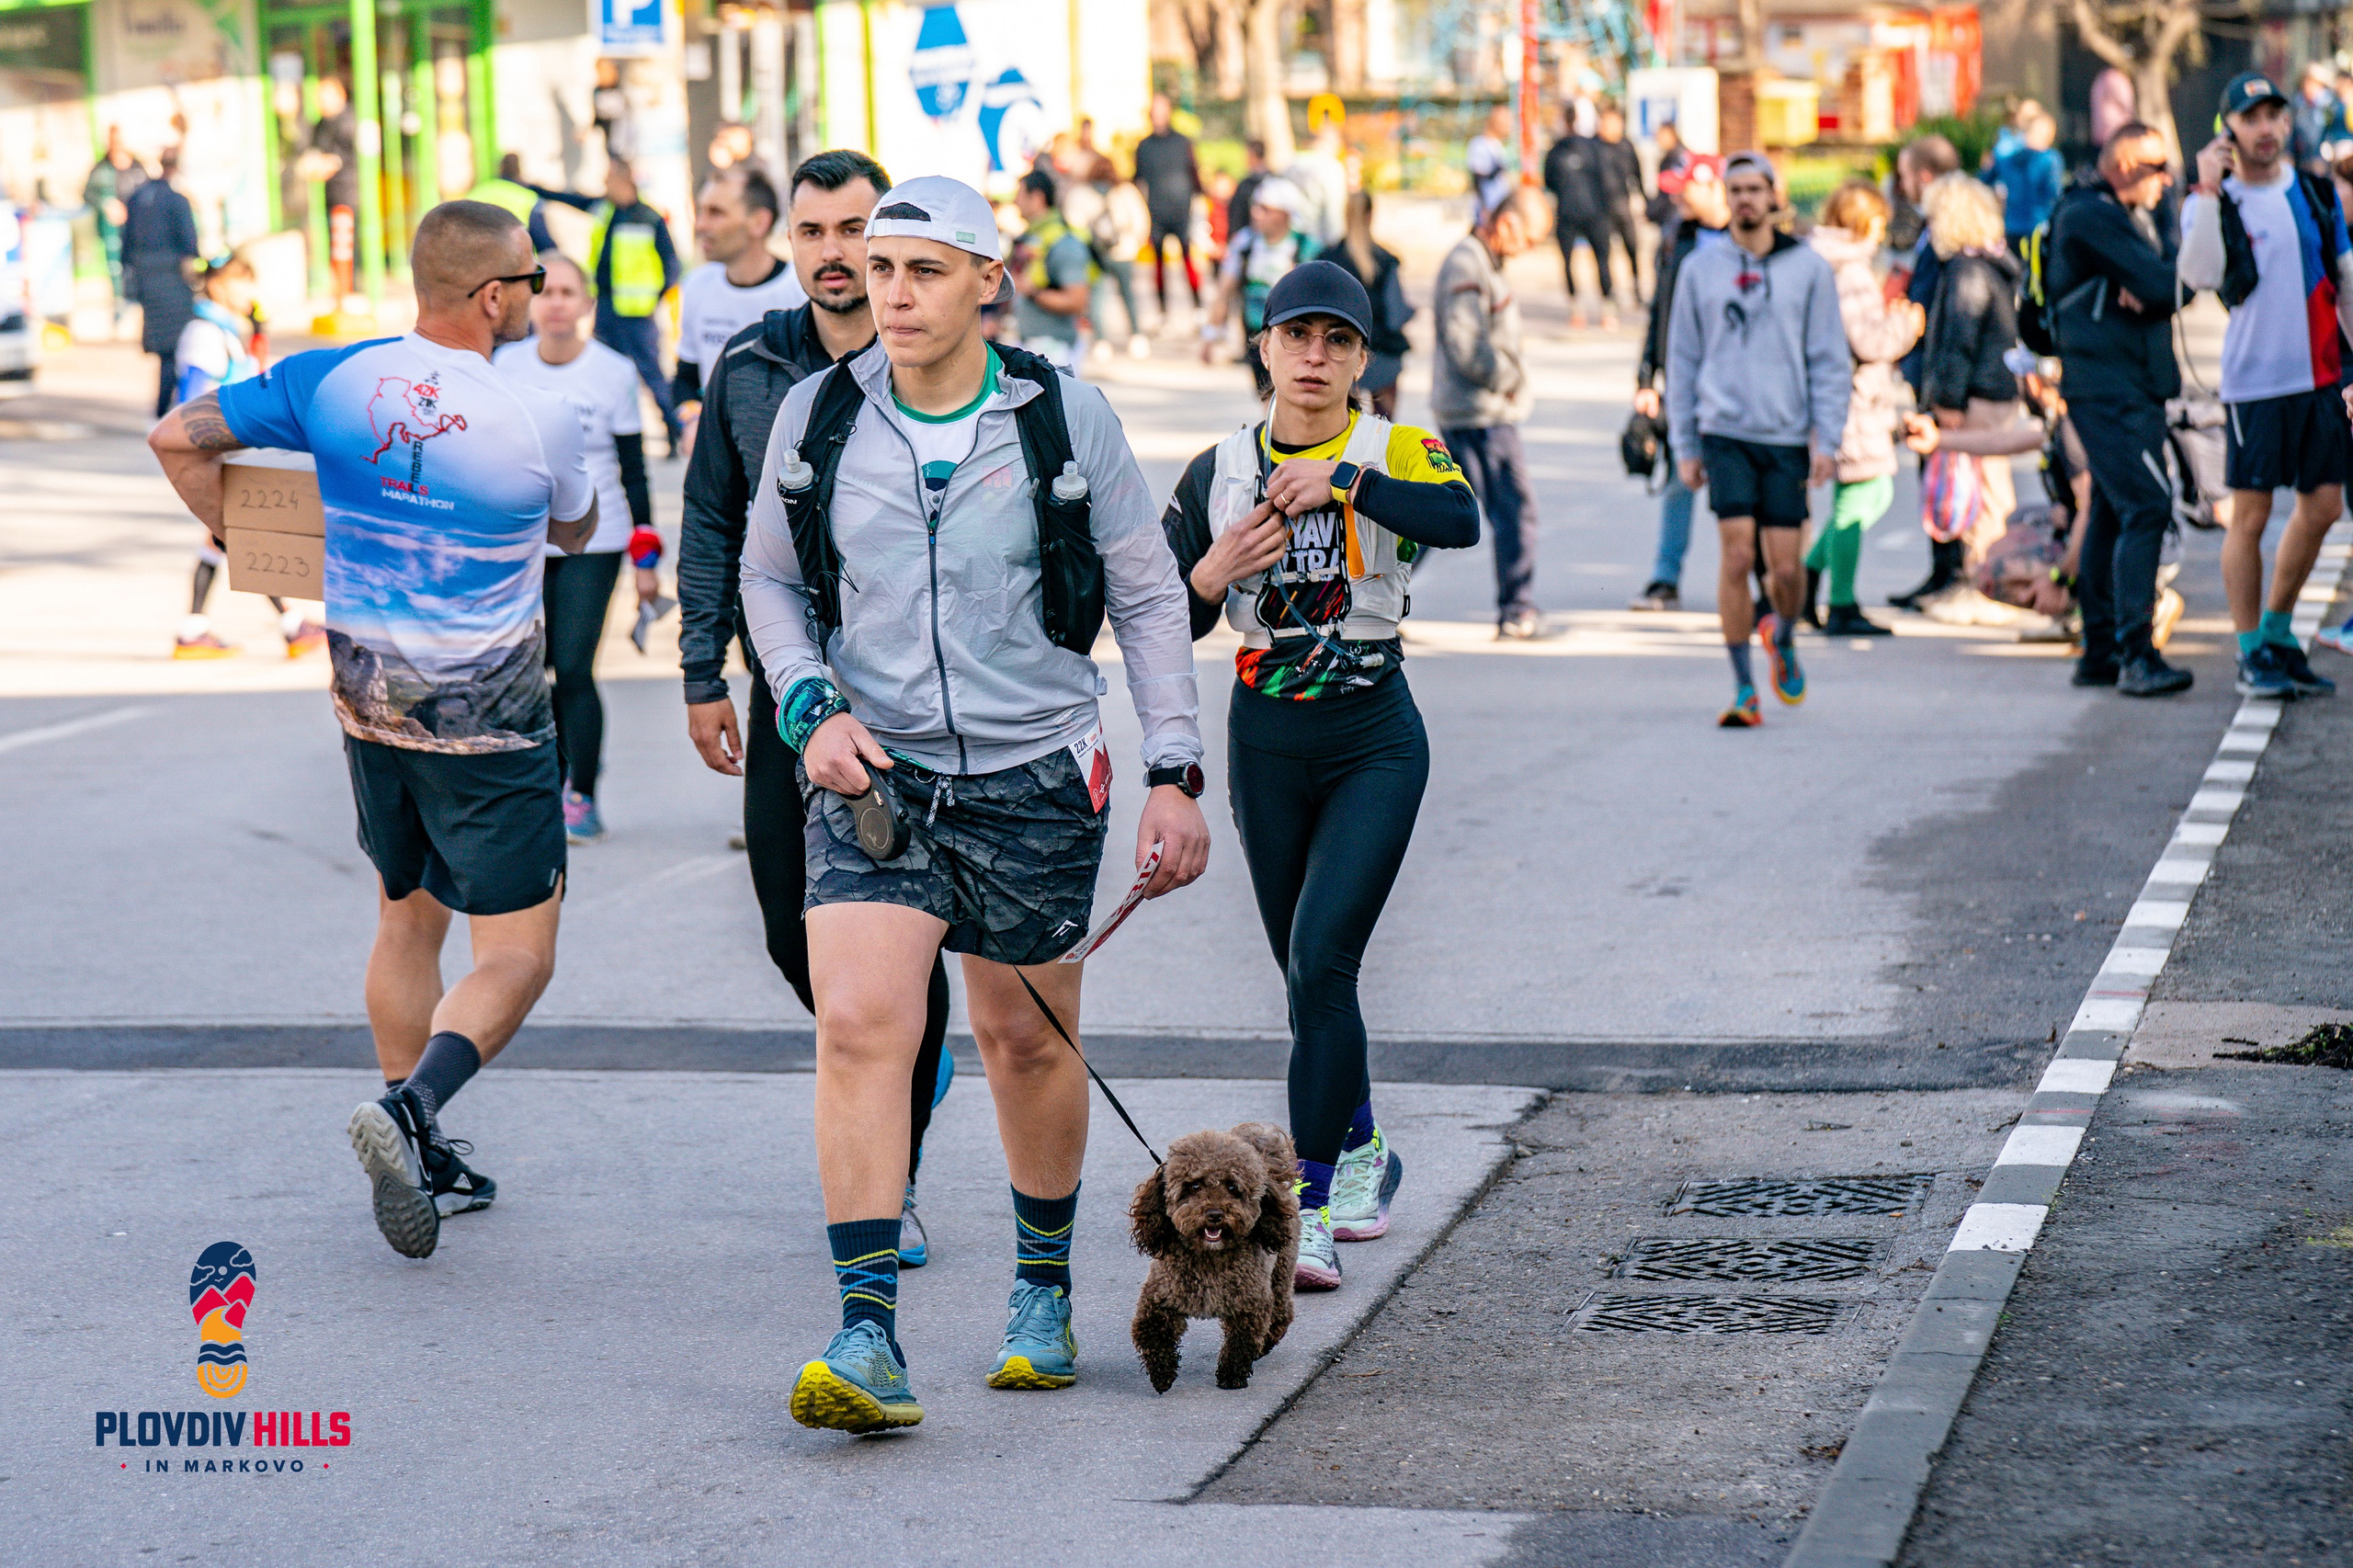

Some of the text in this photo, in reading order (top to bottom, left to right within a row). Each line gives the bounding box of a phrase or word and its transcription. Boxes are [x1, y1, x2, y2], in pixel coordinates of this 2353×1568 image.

[414, 383, 440, 399] 42K
[418, 396, 438, 409] 21K
[241, 489, 299, 510] 2224
[381, 488, 455, 511] MARATHON
[246, 551, 311, 577] 2223
[1074, 737, 1088, 754] 22K
